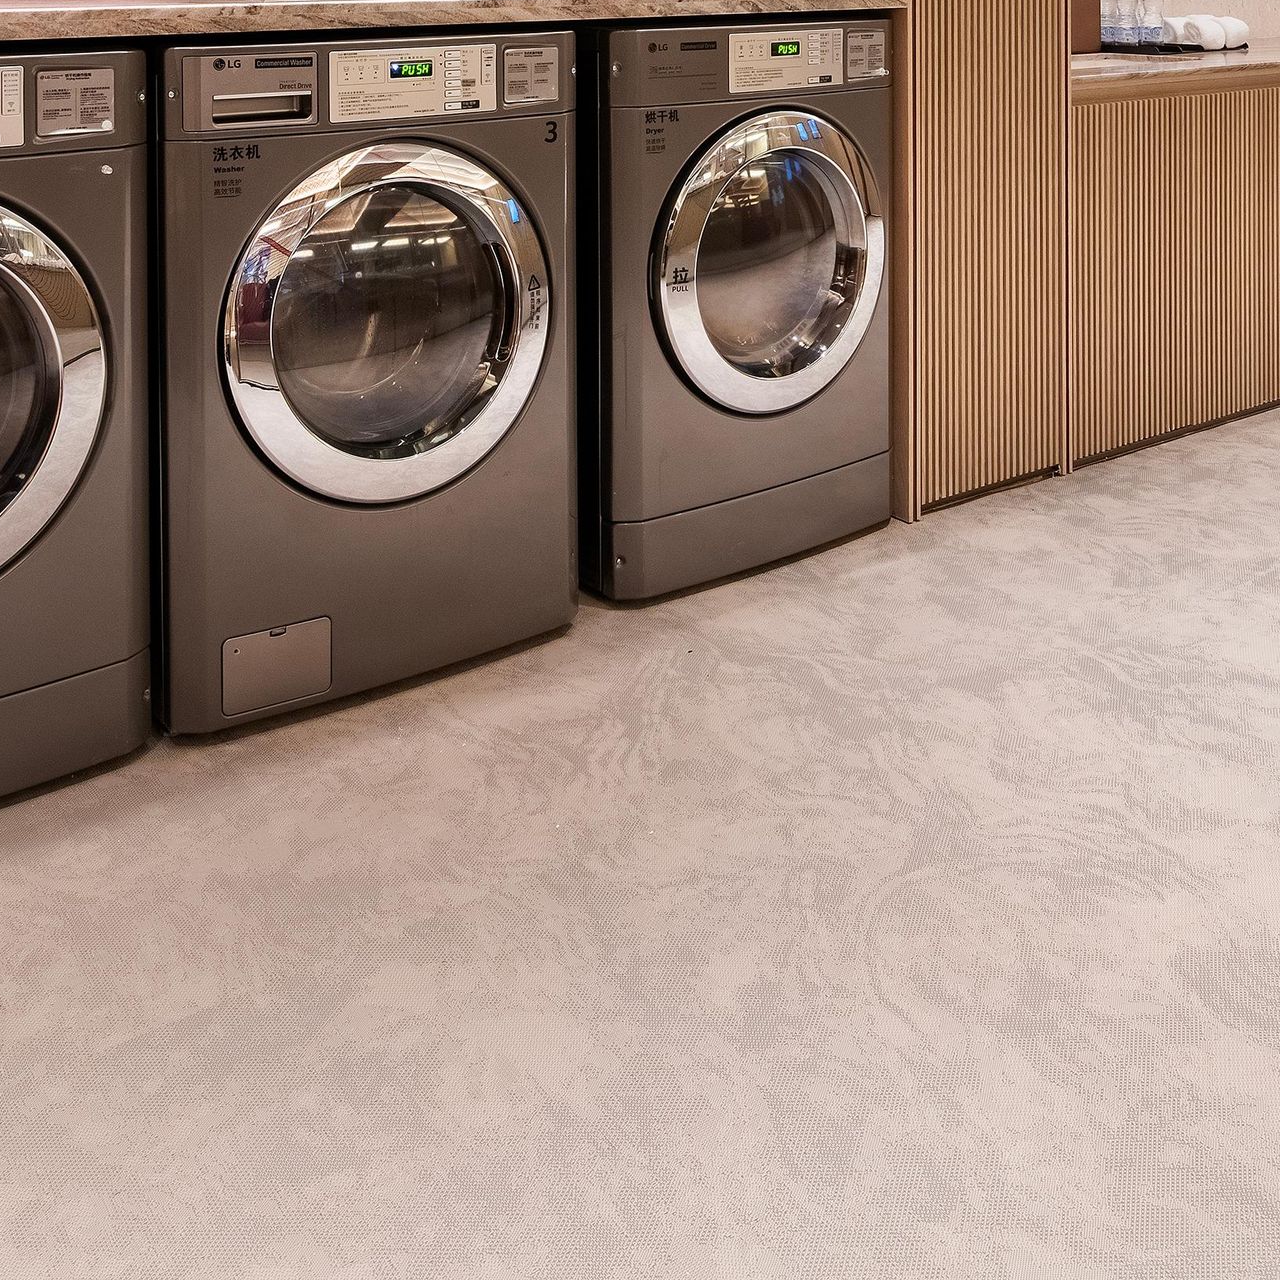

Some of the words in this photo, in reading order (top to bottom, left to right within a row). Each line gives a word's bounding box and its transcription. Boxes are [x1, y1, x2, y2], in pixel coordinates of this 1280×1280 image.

[778, 44, 797, 53] PUSH
[228, 60, 241, 68] LG
[402, 64, 430, 75] PUSH
[645, 110, 679, 123] 烘干机
[544, 121, 557, 142] 3
[213, 144, 260, 162] 洗衣机
[214, 165, 245, 173] Washer
[672, 267, 689, 285] 拉
